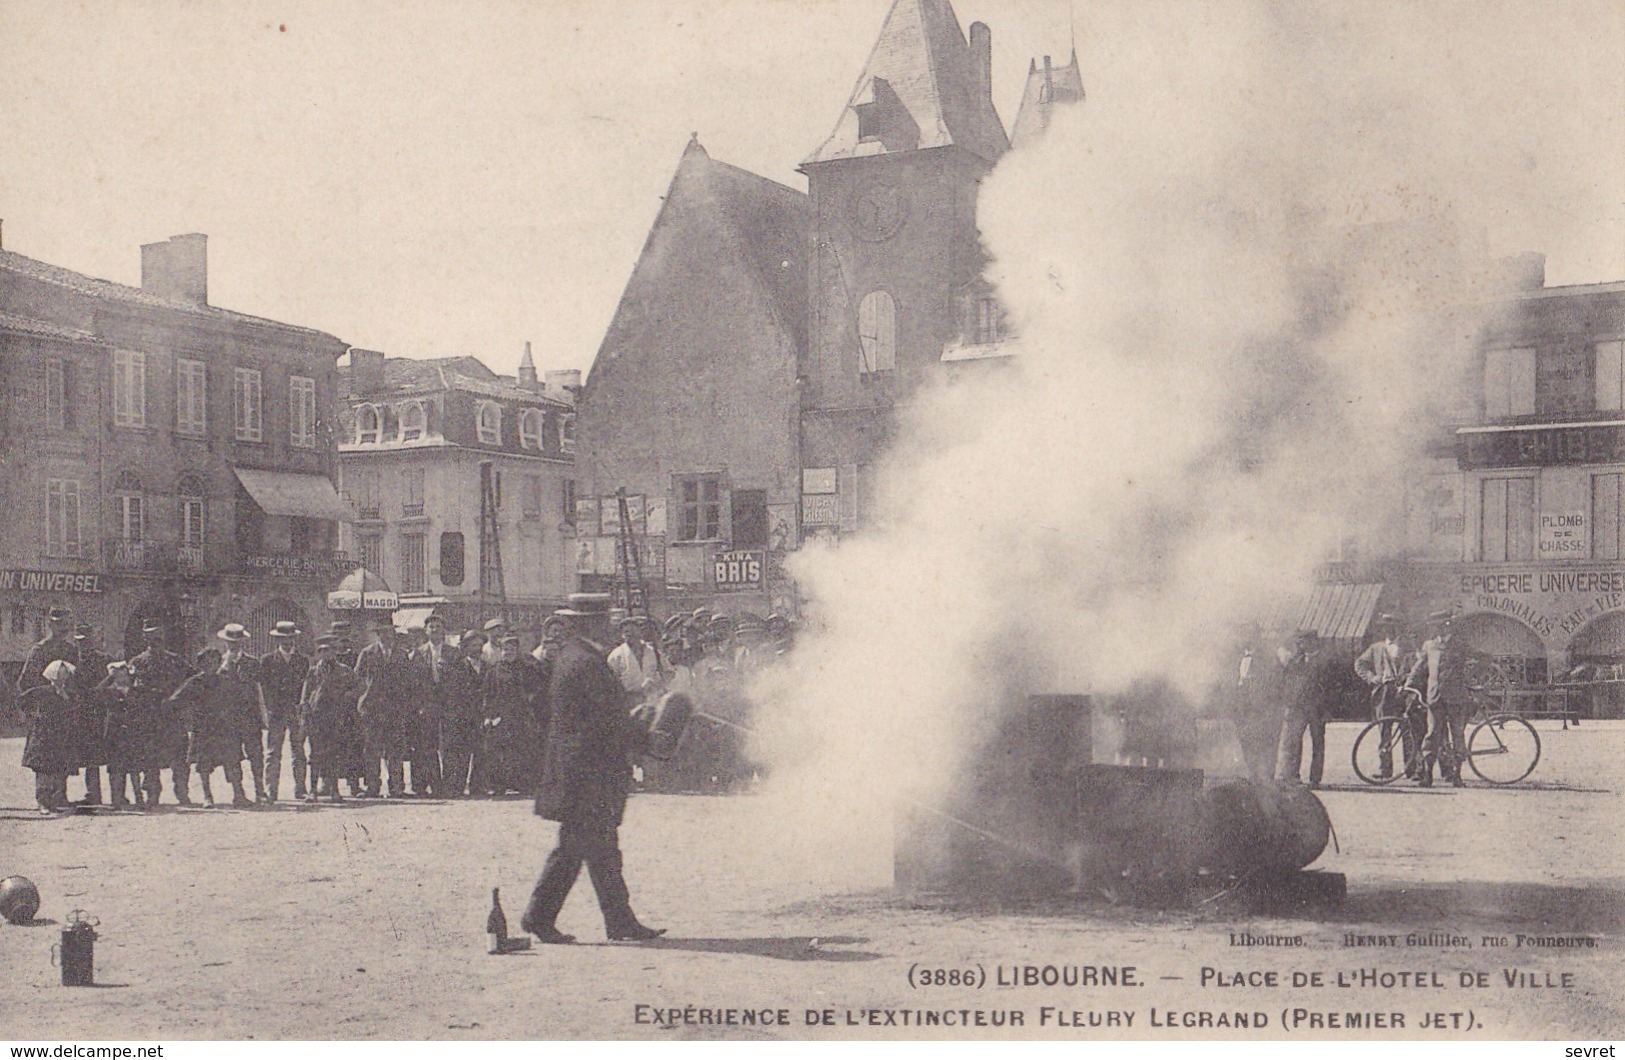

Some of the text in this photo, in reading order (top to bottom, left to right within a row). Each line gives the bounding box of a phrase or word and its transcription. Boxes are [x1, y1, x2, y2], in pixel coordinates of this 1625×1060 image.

[1542, 516, 1583, 527] PLOMB
[1540, 540, 1584, 551] CHASSE
[715, 561, 760, 582] BRIS
[20, 572, 102, 593] UNIVERSEL
[1461, 572, 1625, 593] EPICERIE UNIVERSE
[366, 599, 397, 607] MAGGI
[1560, 607, 1586, 635] EAU
[1594, 592, 1622, 612] VIE
[1477, 594, 1555, 637] COLONIALES
